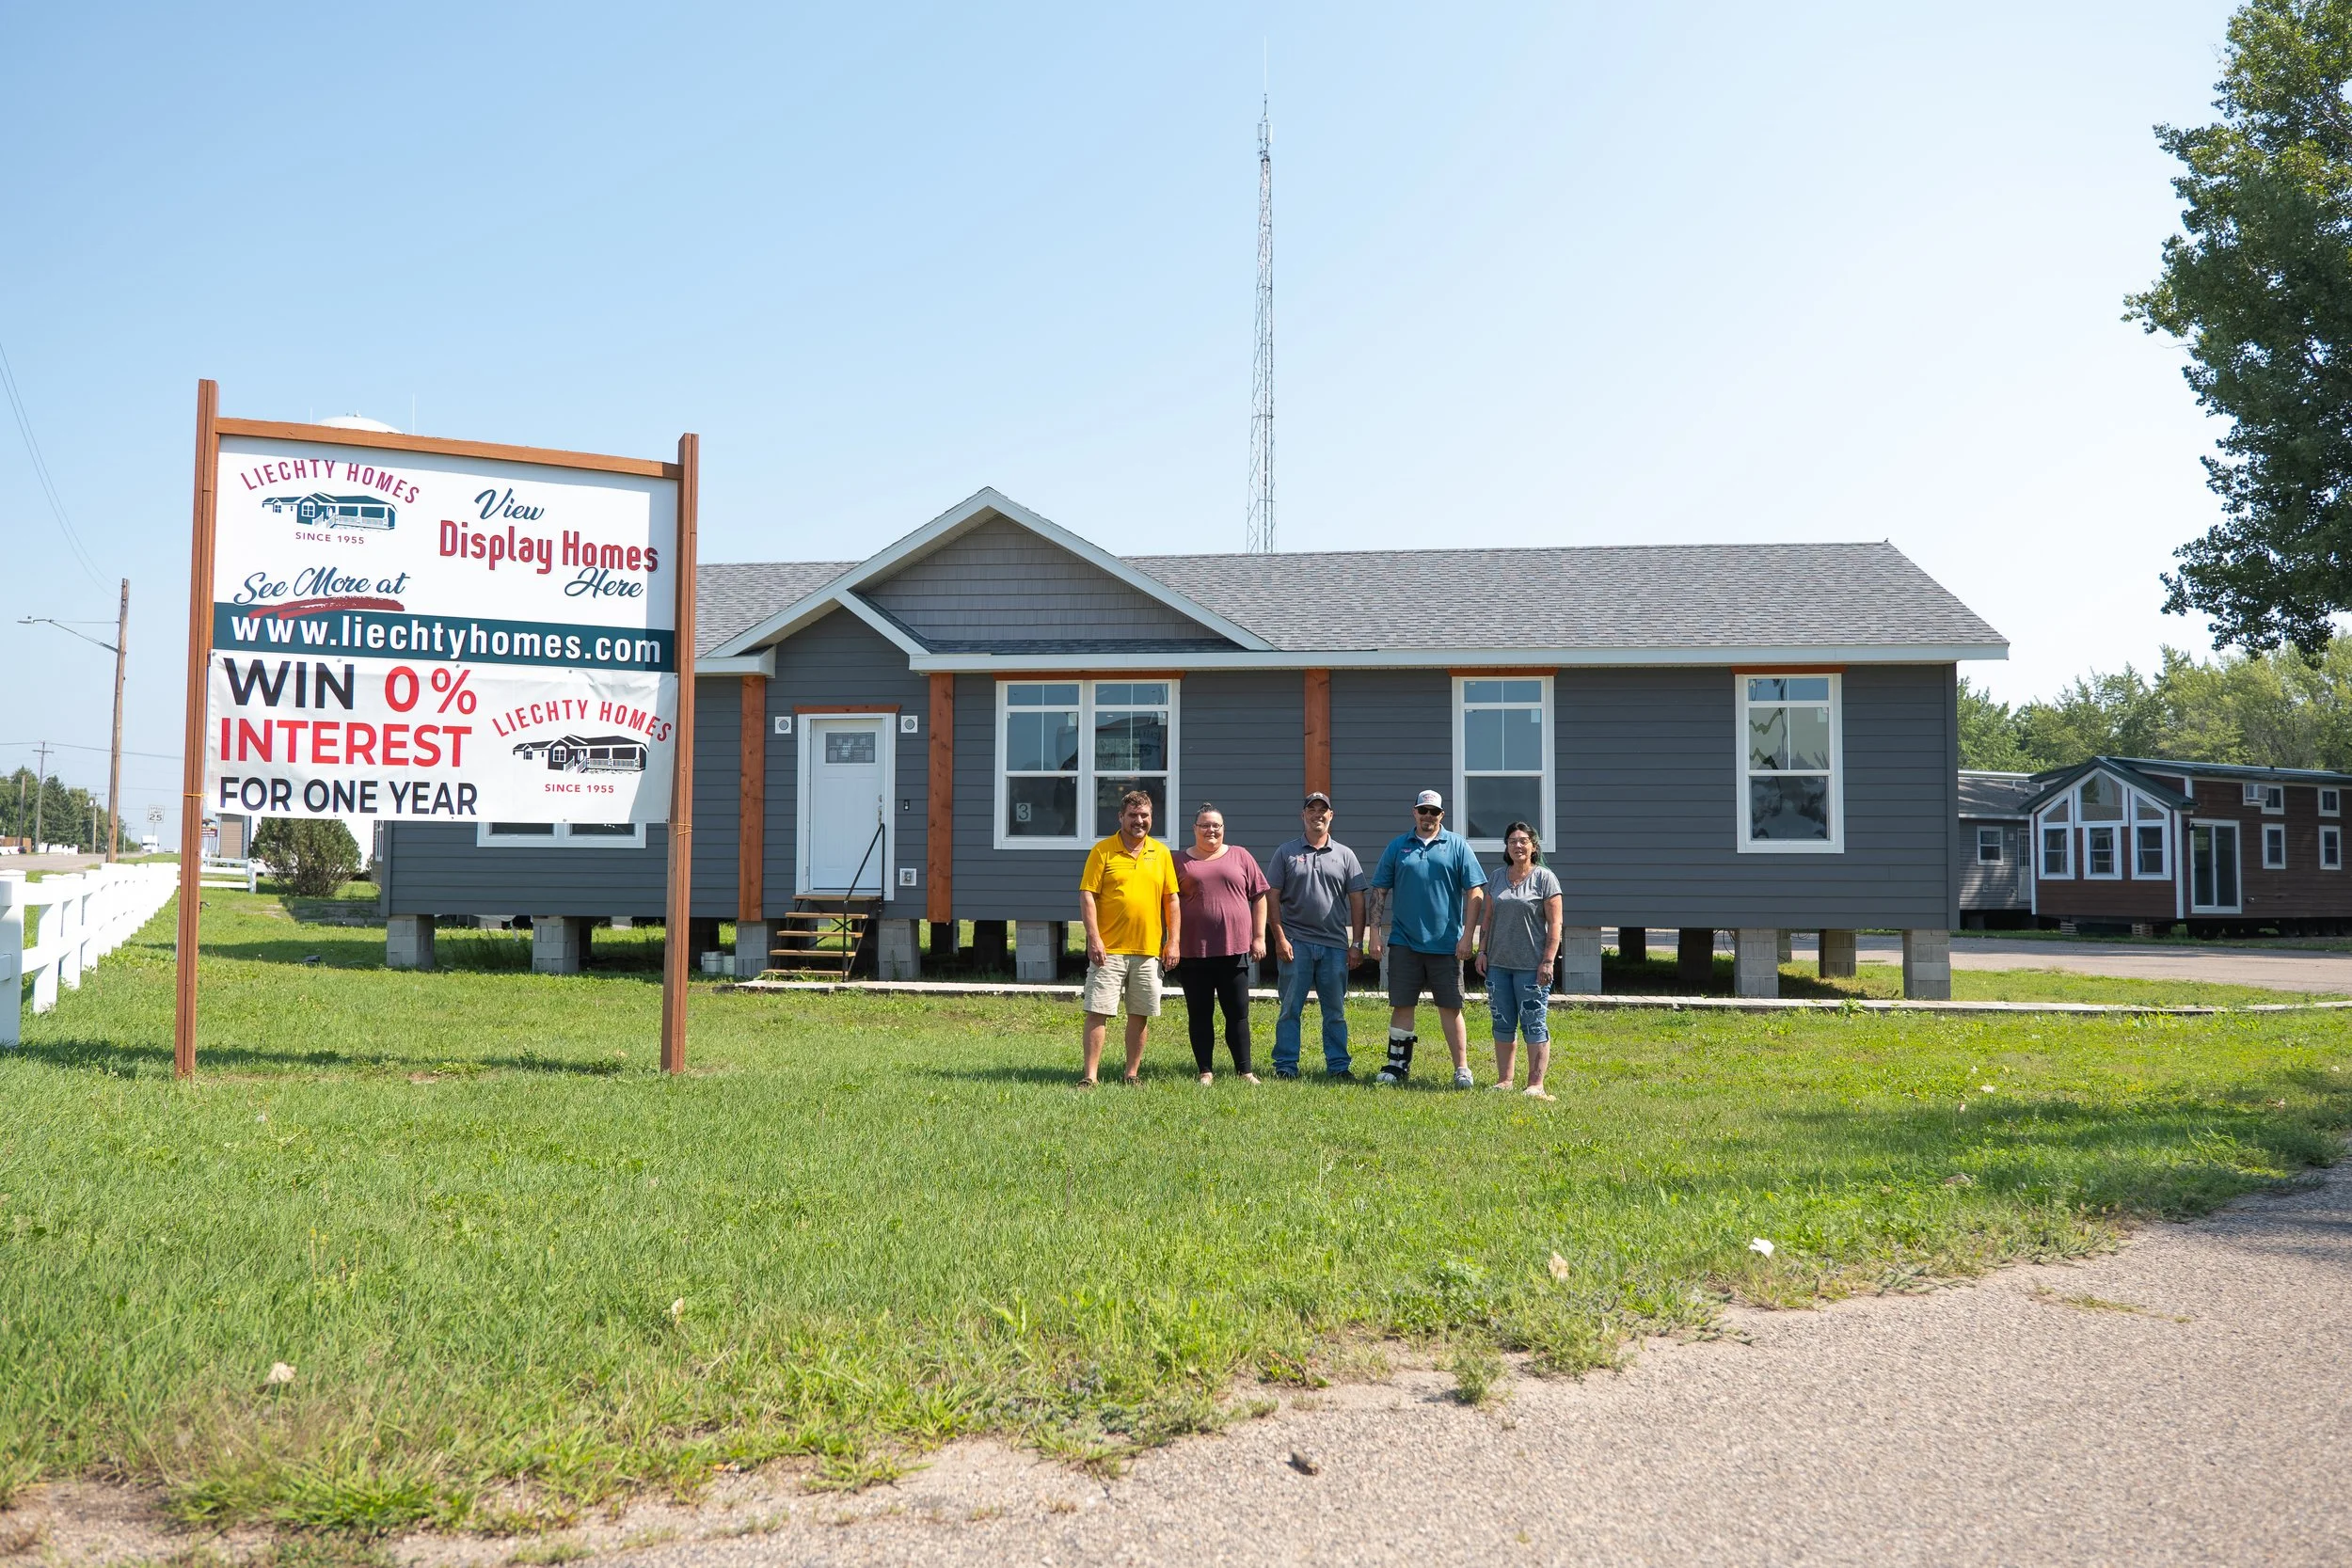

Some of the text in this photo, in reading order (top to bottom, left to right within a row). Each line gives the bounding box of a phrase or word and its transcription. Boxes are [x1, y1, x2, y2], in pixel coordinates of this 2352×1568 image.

[241, 459, 420, 503] LIECHTY HOMES
[474, 488, 544, 521] View
[295, 531, 365, 545] SINCE 1955
[440, 520, 658, 575] Display Homes
[233, 566, 411, 606] See More at
[564, 566, 644, 598] Here
[231, 615, 661, 663] www.liechtyhomes.com
[223, 657, 477, 715] WIN 0%
[492, 699, 671, 741] LIECHTY HOMES
[220, 718, 472, 768] INTEREST
[220, 777, 478, 816] FOR ONE YEAR
[545, 784, 614, 794] SINCE 1955
[1018, 803, 1029, 820] 3
